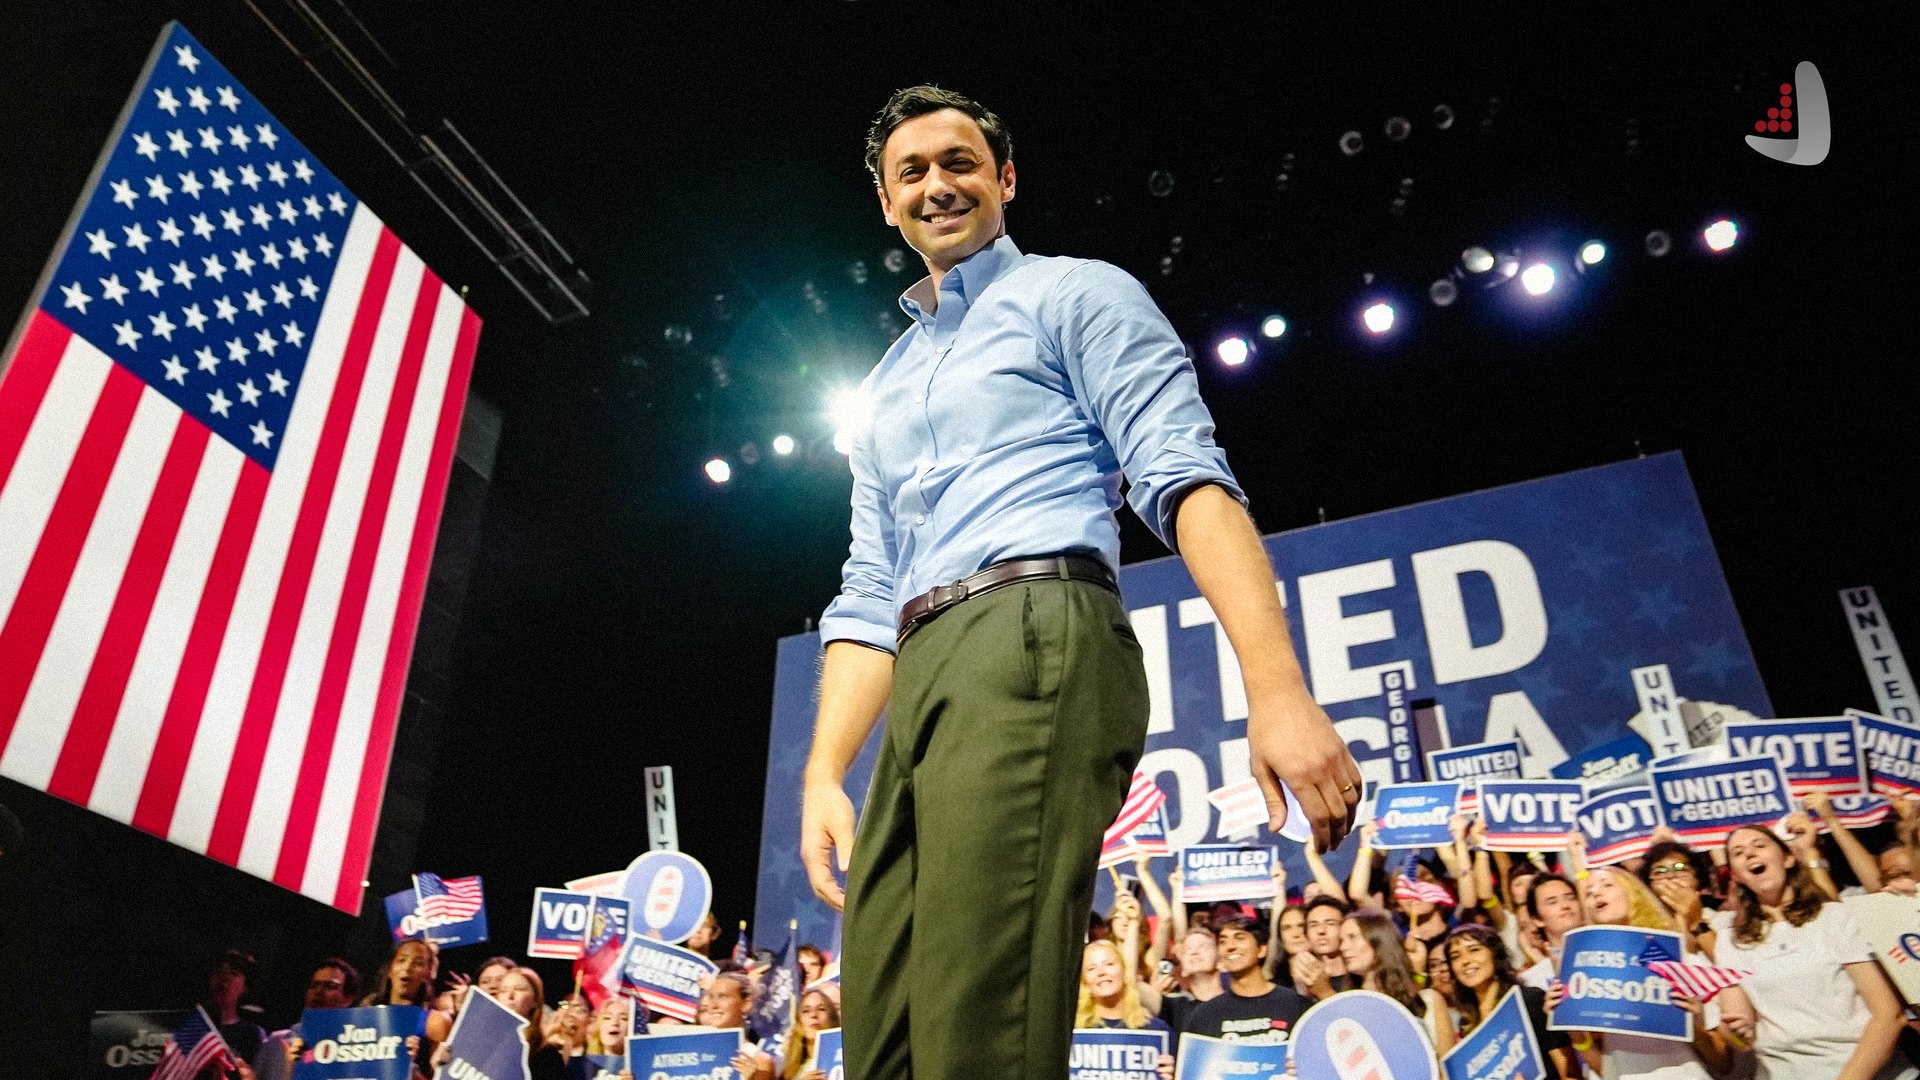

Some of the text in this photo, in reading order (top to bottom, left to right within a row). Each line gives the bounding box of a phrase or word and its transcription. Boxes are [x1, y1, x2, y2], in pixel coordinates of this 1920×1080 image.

[1384, 671, 1411, 780] GEORGI
[1439, 750, 1519, 780] UNITED
[1731, 732, 1853, 768] VOTE
[1661, 768, 1777, 805] UNITED
[1485, 793, 1581, 823] VOTE
[1577, 798, 1657, 840] VOT
[1681, 793, 1785, 823] GEORGIA
[1188, 850, 1269, 869] UNITED
[1568, 971, 1672, 1005] Ossoff
[338, 1024, 377, 1044] Jon
[314, 1035, 402, 1064] Ossoff
[1068, 1044, 1160, 1070] UNITED
